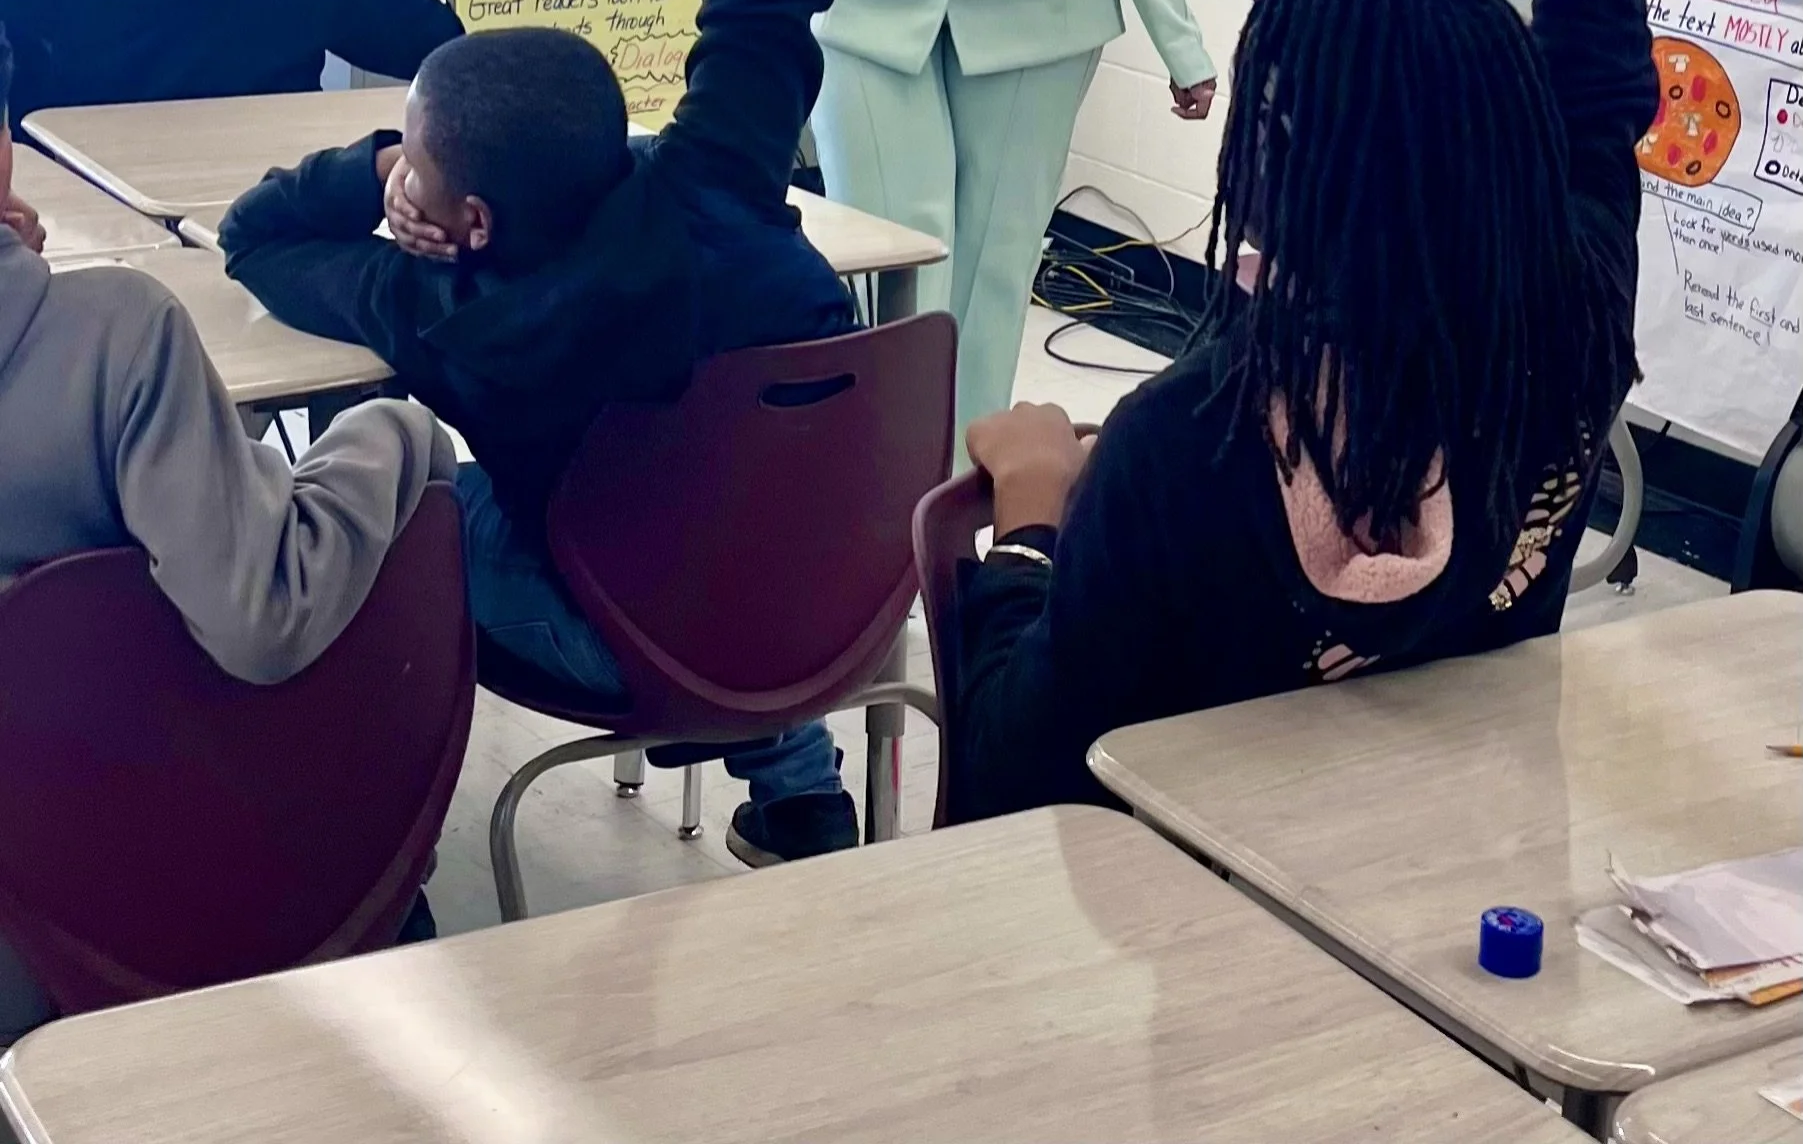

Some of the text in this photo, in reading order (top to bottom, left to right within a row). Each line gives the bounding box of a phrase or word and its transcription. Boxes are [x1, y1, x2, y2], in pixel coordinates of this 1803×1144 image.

[605, 7, 665, 35] through
[1678, 0, 1716, 36] text
[1724, 15, 1789, 53] MOSTLY
[1664, 182, 1684, 200] the
[1687, 192, 1713, 210] main
[1673, 226, 1697, 247] than
[1701, 217, 1716, 234] for
[1721, 229, 1750, 247] words
[1752, 240, 1779, 256] used
[1784, 247, 1803, 263] mo
[1685, 296, 1704, 318] last
[1726, 285, 1745, 311] the
[1750, 296, 1776, 324] first
[1780, 317, 1800, 334] and
